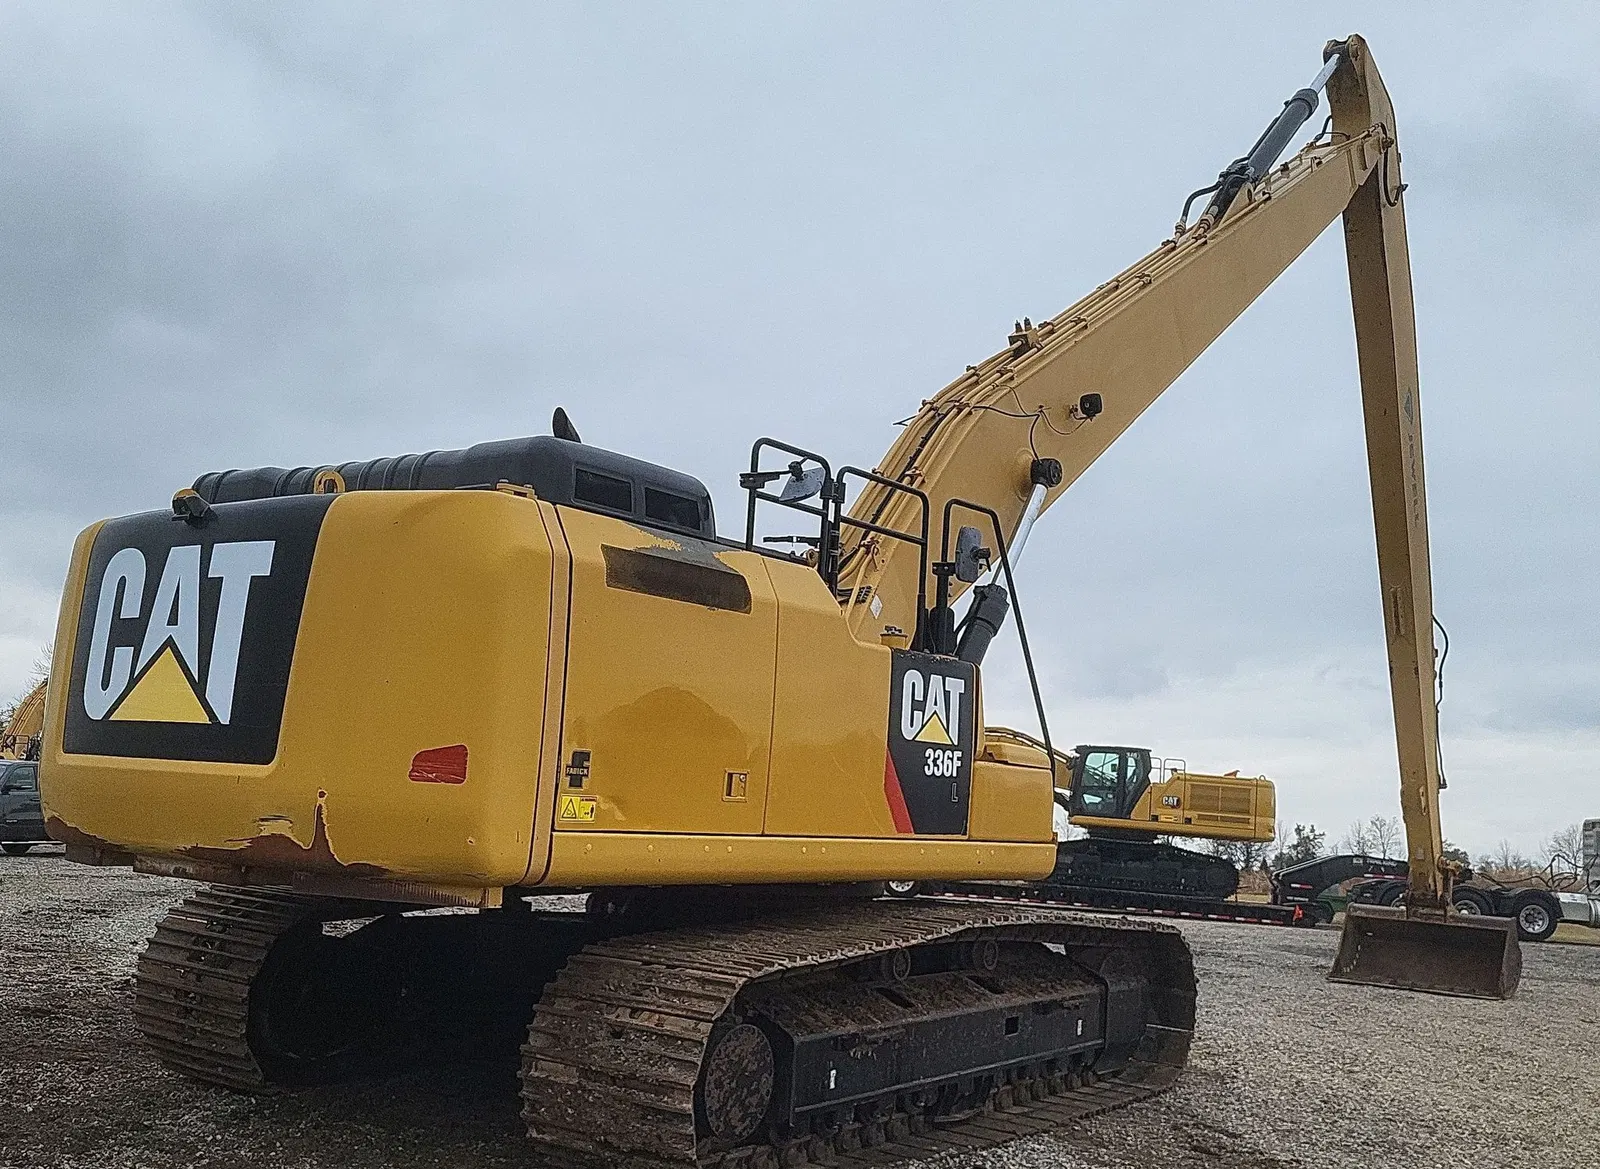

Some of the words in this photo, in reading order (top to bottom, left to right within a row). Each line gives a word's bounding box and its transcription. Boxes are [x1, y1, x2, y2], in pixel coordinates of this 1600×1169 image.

[84, 540, 276, 725] CAT
[901, 669, 965, 746] CAT
[924, 748, 962, 778] 336F
[951, 782, 959, 803] L
[1162, 796, 1179, 807] CAT
